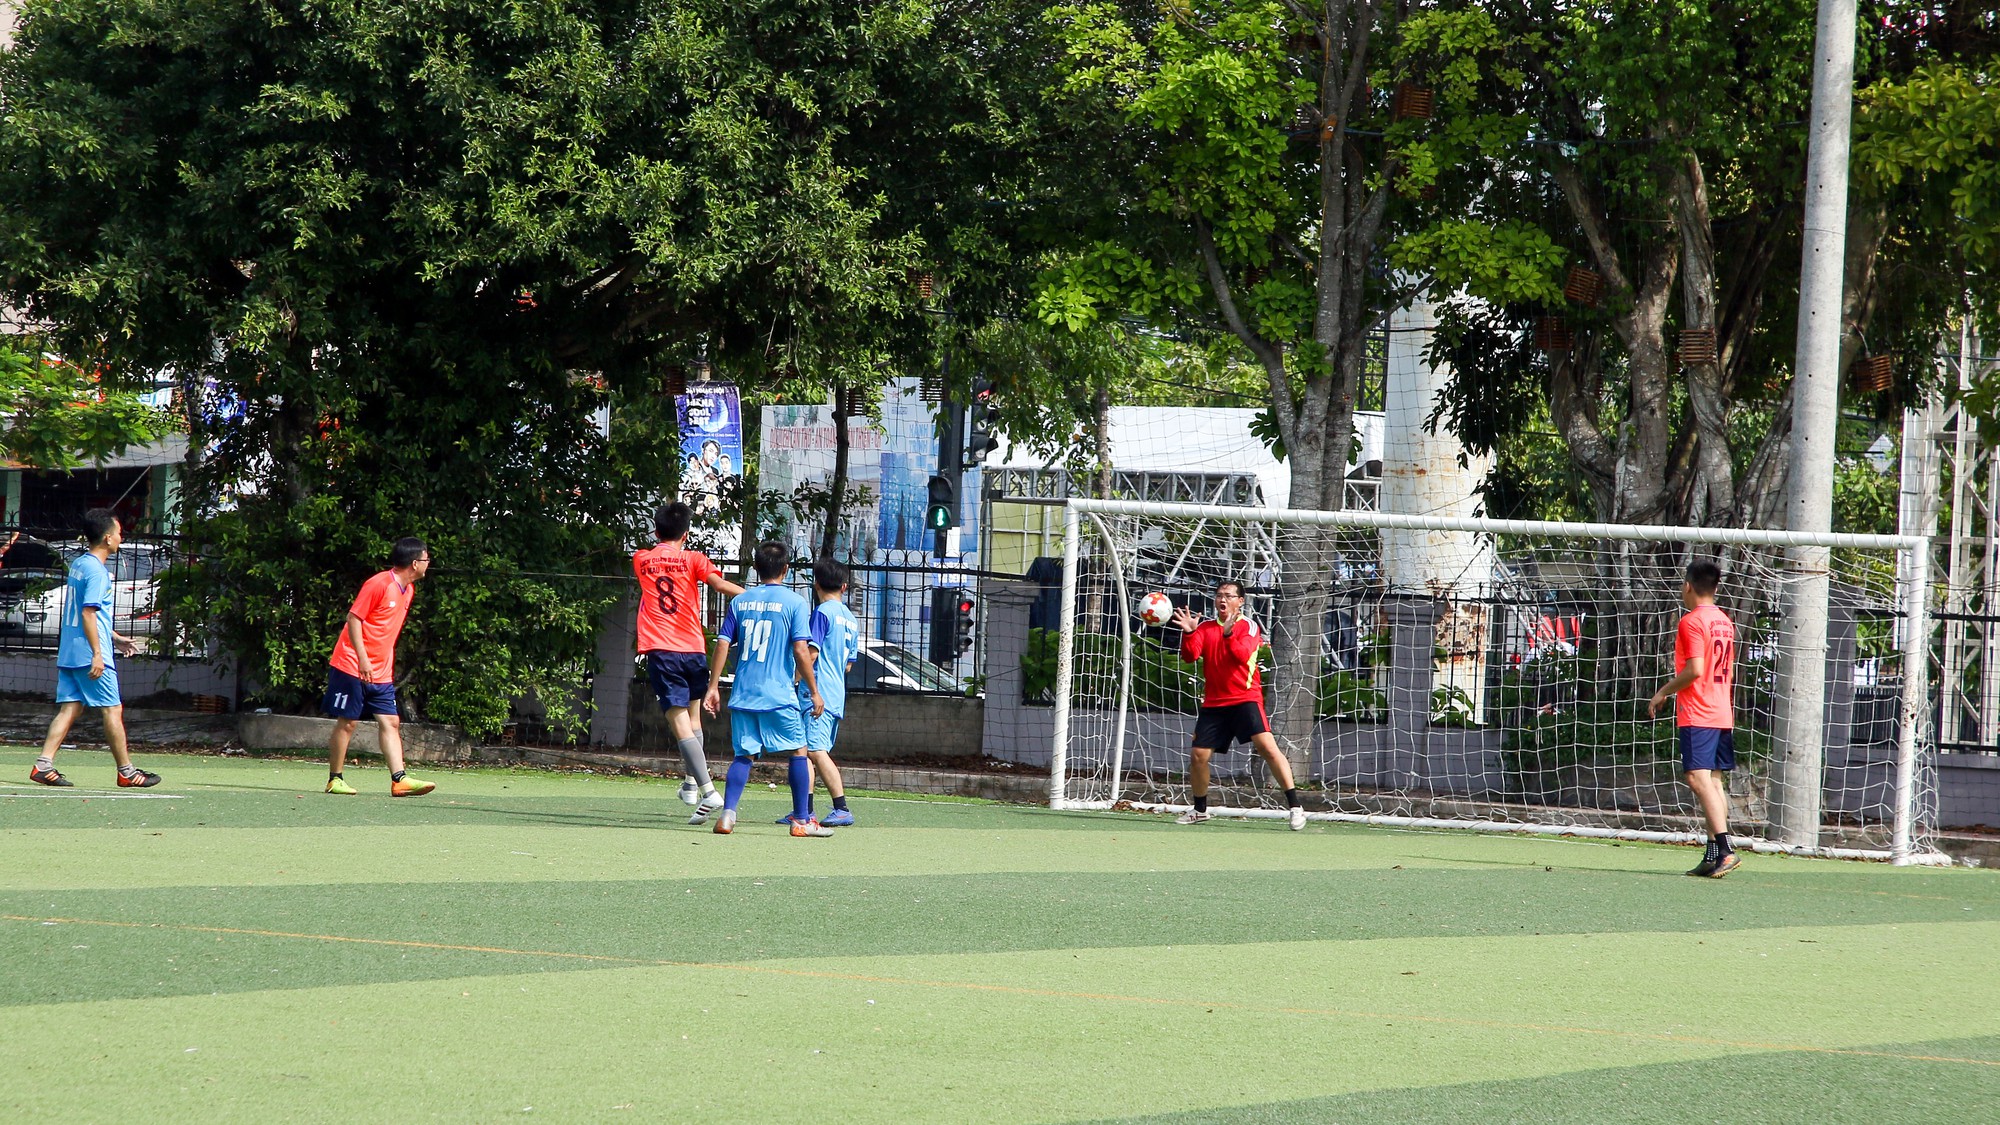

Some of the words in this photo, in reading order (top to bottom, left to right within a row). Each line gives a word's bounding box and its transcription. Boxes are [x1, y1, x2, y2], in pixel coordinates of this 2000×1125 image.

[656, 576, 678, 614] 8
[741, 619, 773, 663] 14
[1713, 640, 1731, 684] 24
[333, 692, 348, 710] 11
